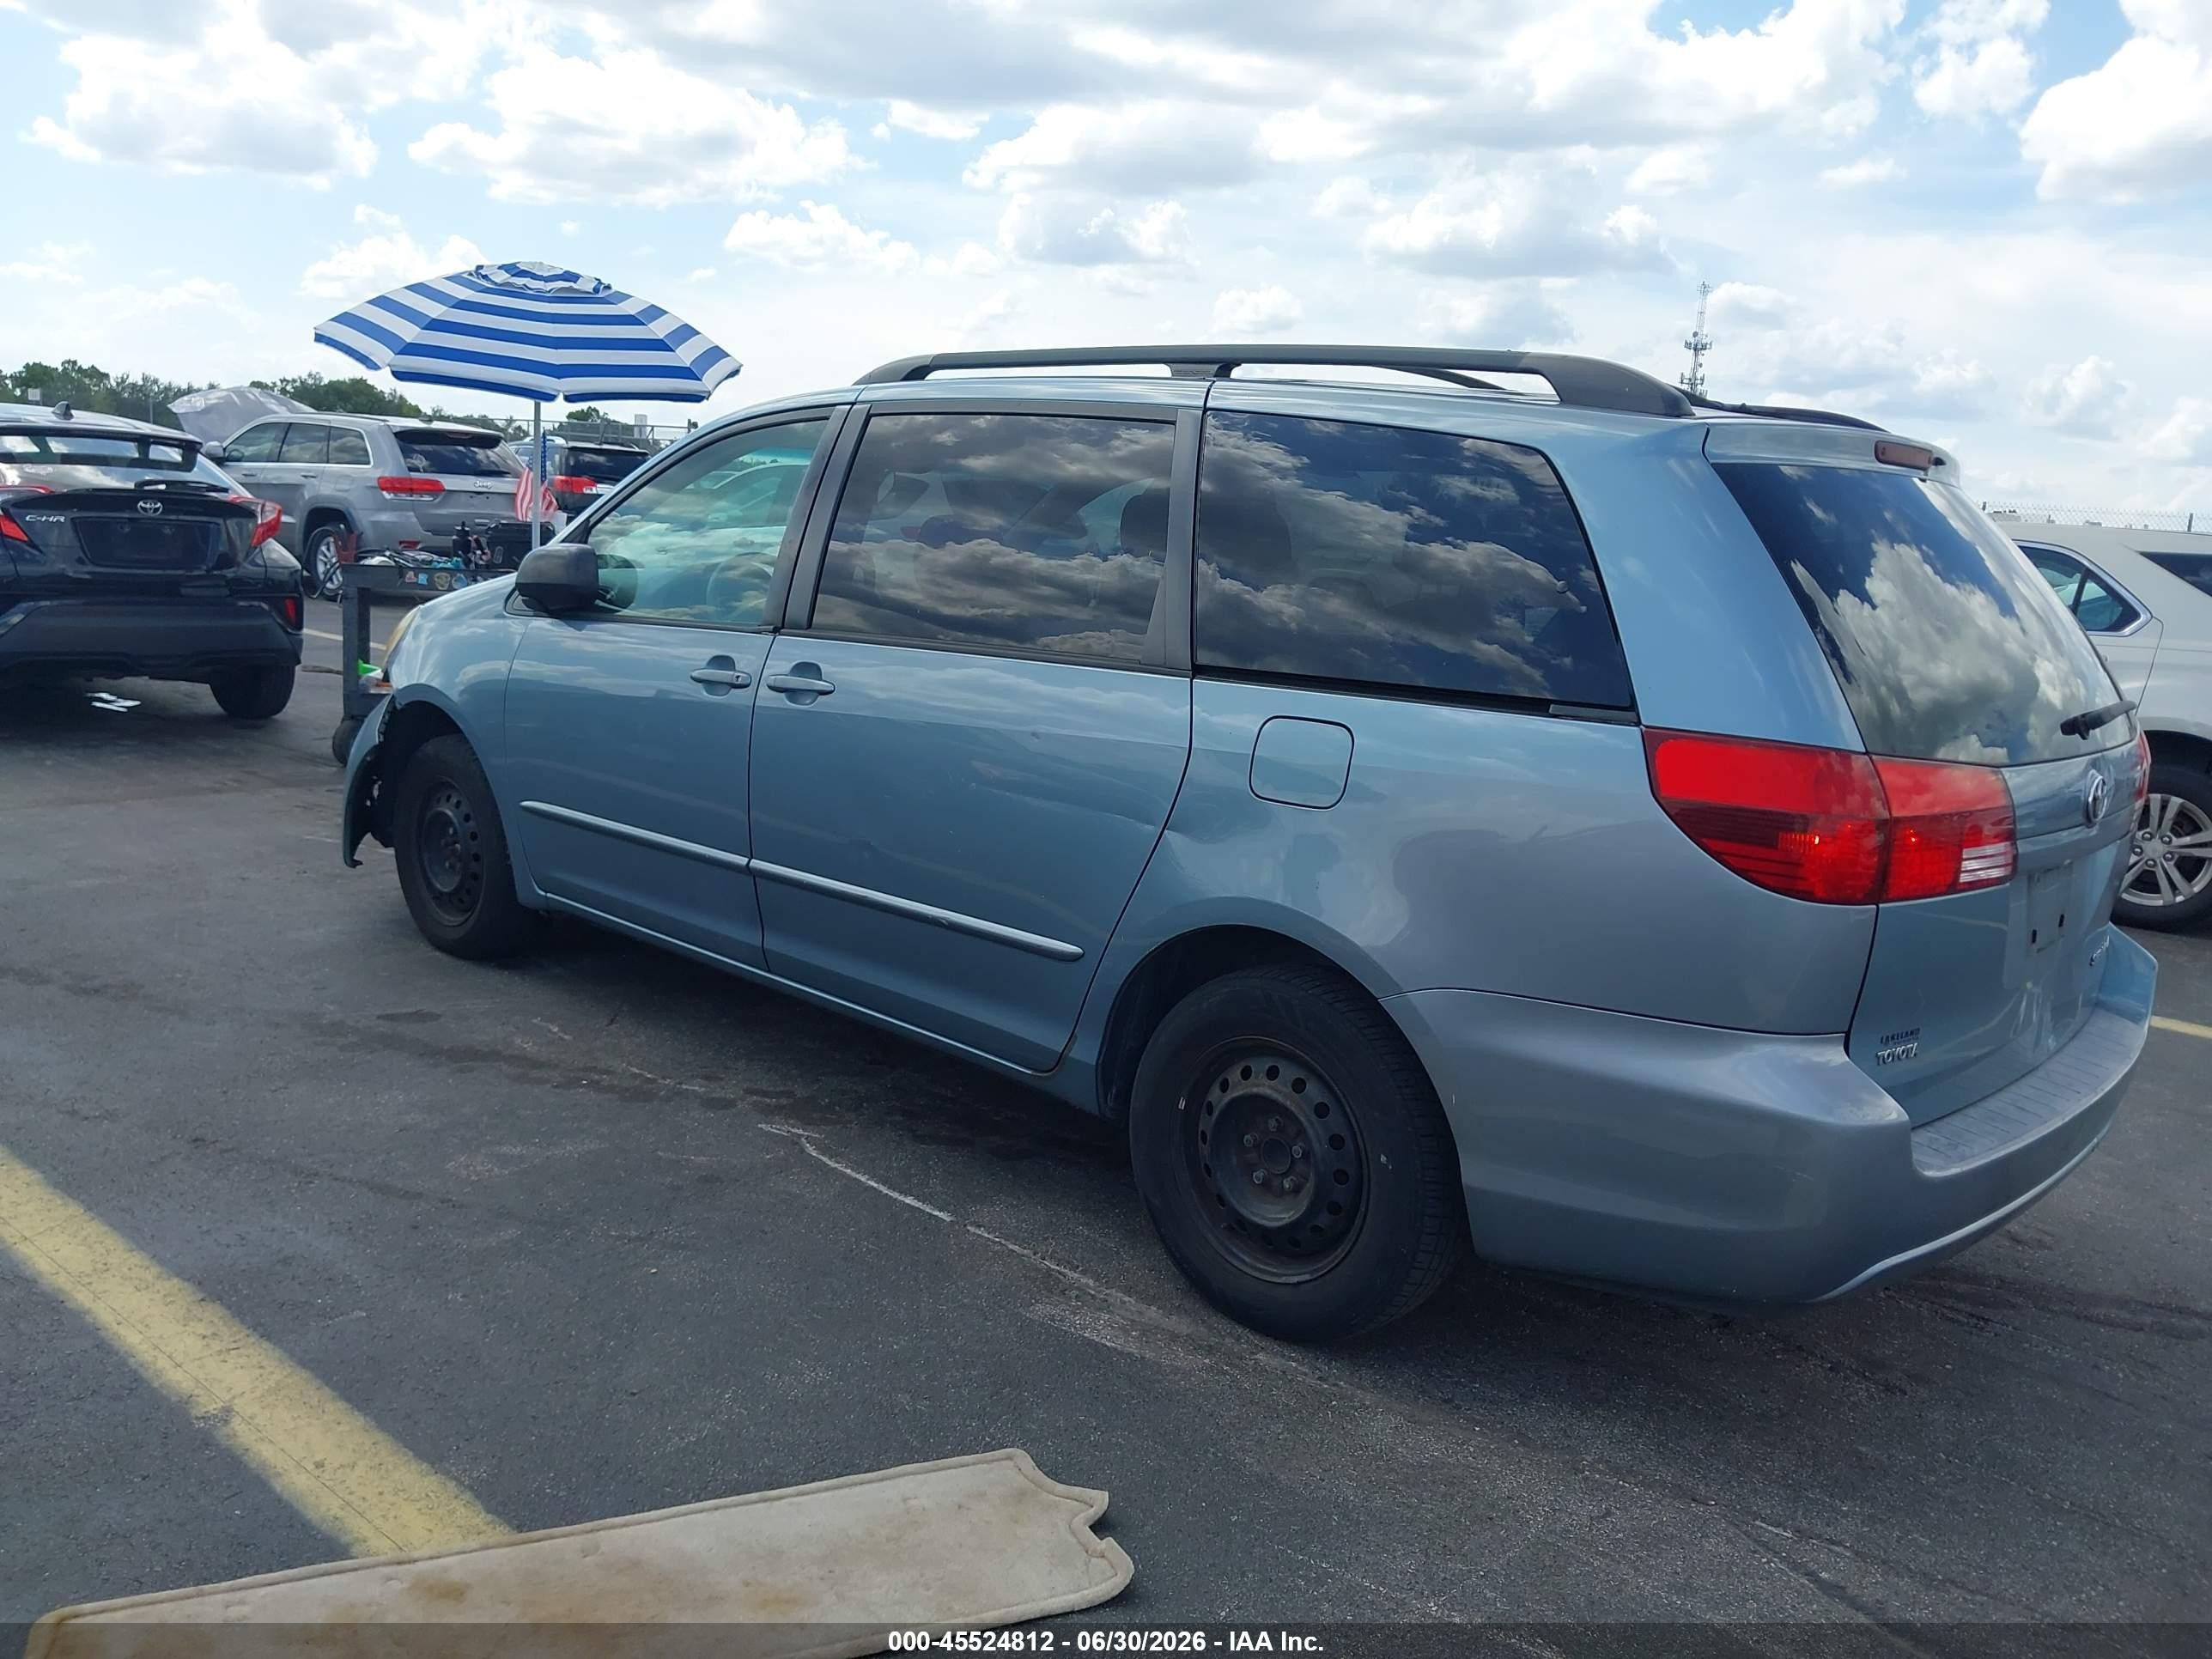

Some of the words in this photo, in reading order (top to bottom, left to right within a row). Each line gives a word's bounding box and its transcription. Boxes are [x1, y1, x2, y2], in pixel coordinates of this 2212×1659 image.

[473, 480, 494, 489] Jeep
[25, 514, 66, 523] C-HR
[1876, 1042, 1917, 1066] TOYOTA
